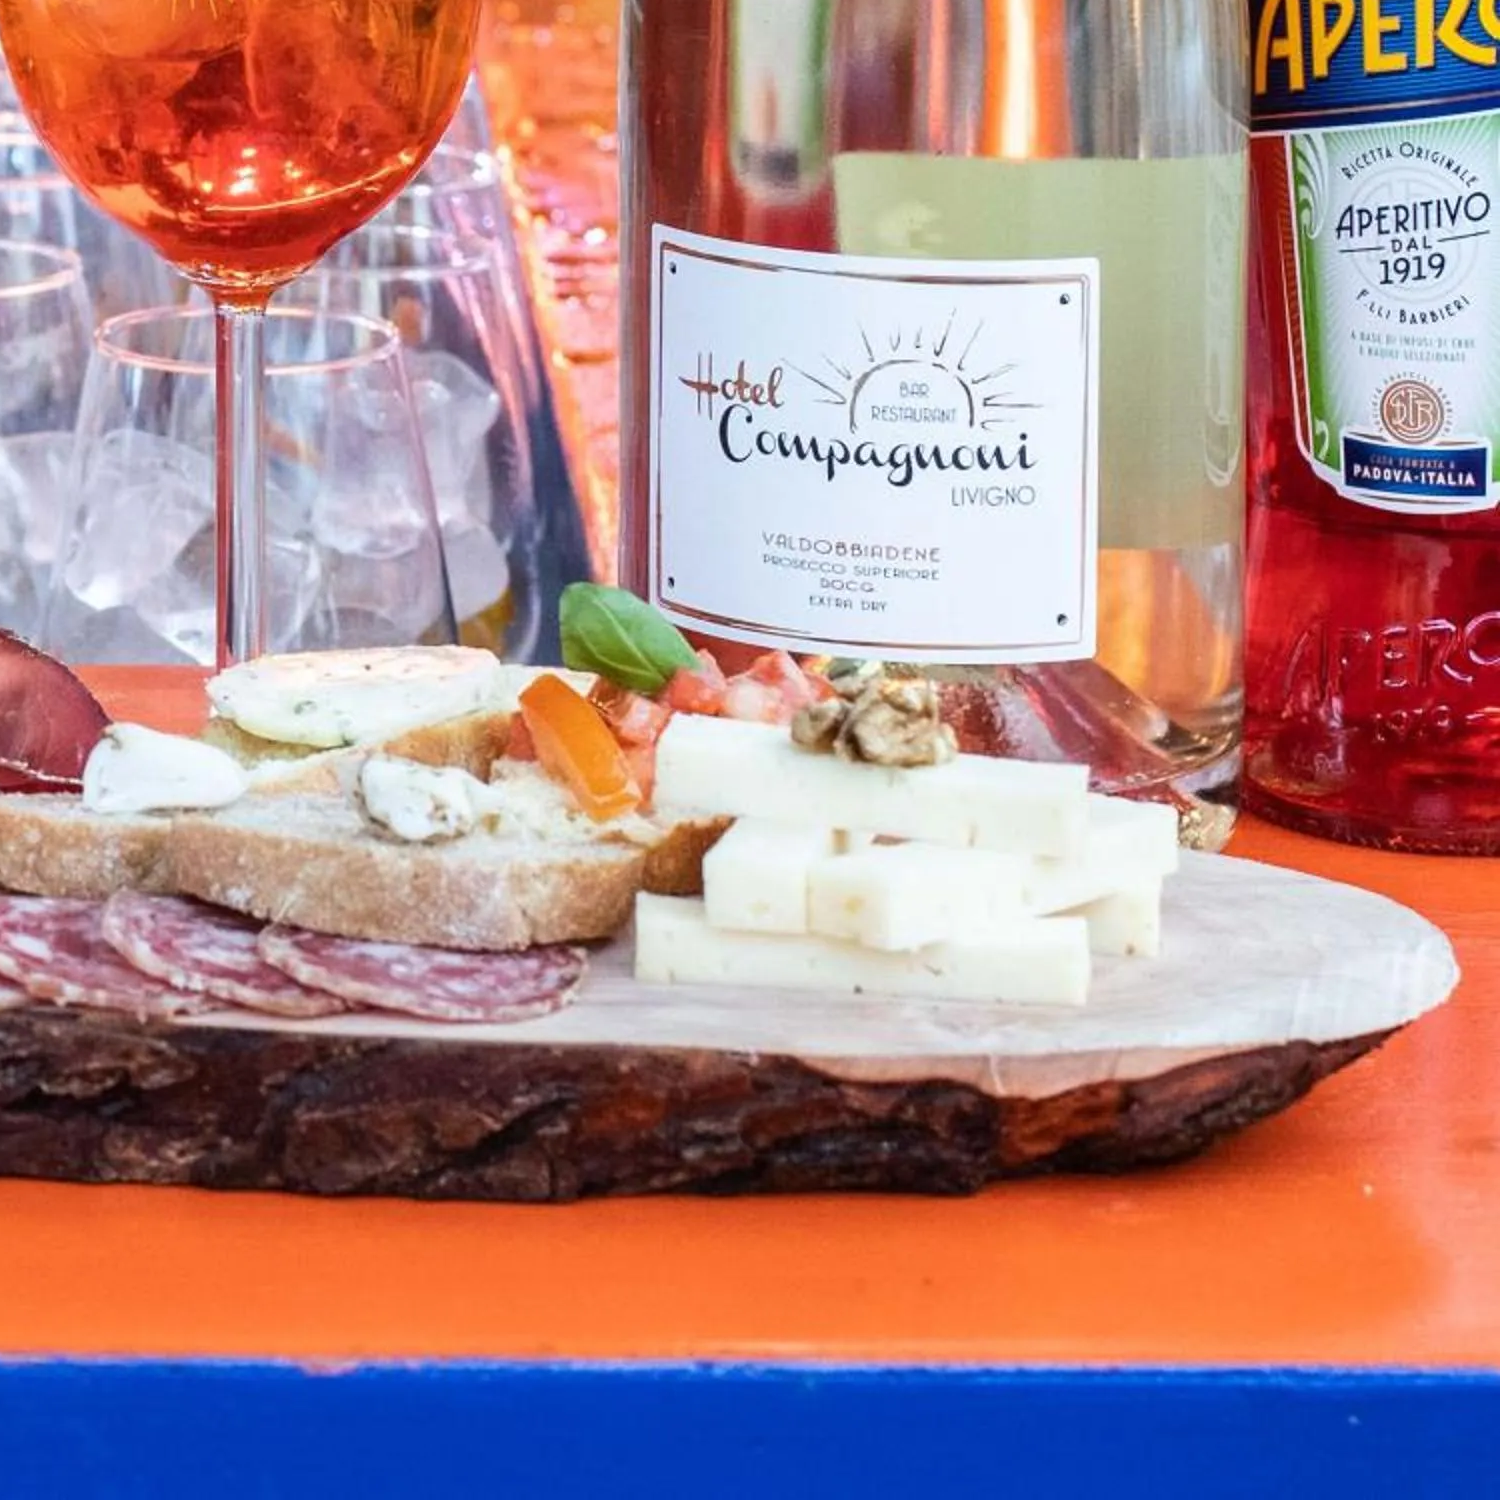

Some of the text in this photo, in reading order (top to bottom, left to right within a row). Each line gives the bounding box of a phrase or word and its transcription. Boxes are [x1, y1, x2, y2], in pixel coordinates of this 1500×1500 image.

[1341, 141, 1479, 188] RICETTA ORIGINALE
[1336, 191, 1491, 239] APERITIVO
[1391, 235, 1433, 253] DAL
[1379, 252, 1446, 285] 1919
[1399, 294, 1471, 325] BARBIERI
[678, 351, 784, 421] Hotel
[899, 381, 930, 398] BAR
[871, 405, 957, 423] RESTAURANT
[718, 403, 1037, 487] Compagnoni
[951, 485, 1036, 506] LIVIGNO
[761, 530, 941, 563] VALDOBBIADENE
[762, 553, 940, 581] PROSECCO SUPERIORE
[819, 577, 875, 593] DOCG
[808, 595, 888, 612] EXTRA DRY
